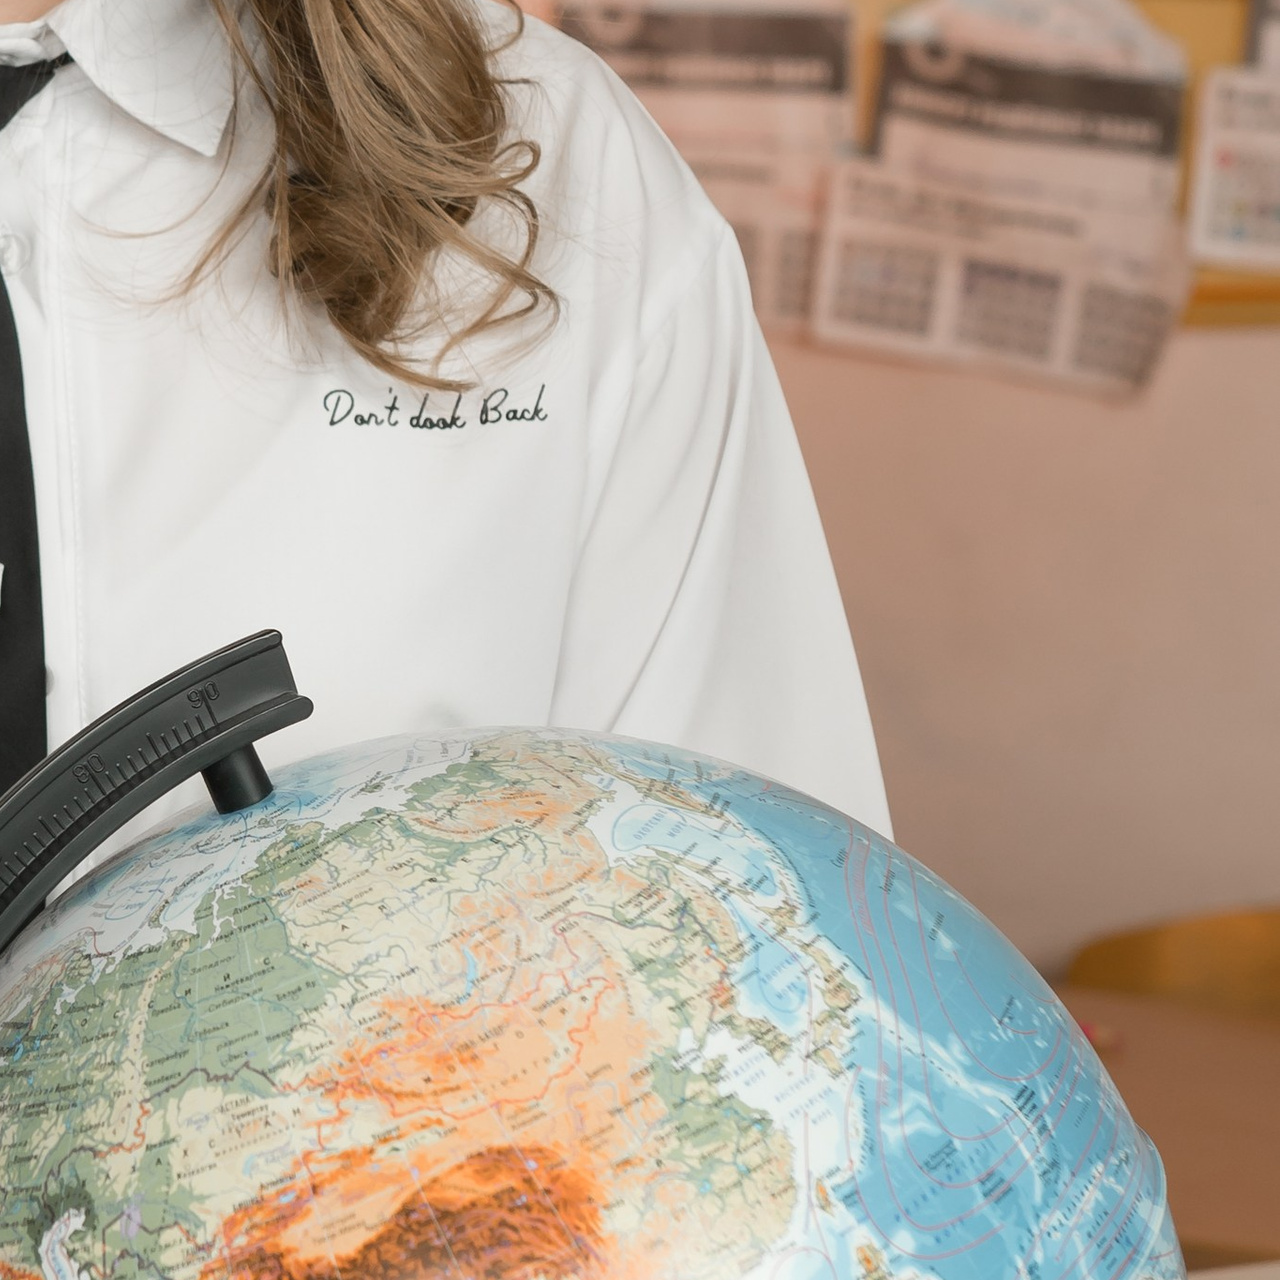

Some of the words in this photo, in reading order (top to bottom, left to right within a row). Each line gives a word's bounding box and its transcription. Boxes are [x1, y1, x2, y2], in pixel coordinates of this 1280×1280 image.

[480, 384, 548, 425] Back
[187, 680, 220, 709] 90
[72, 752, 107, 785] 80
